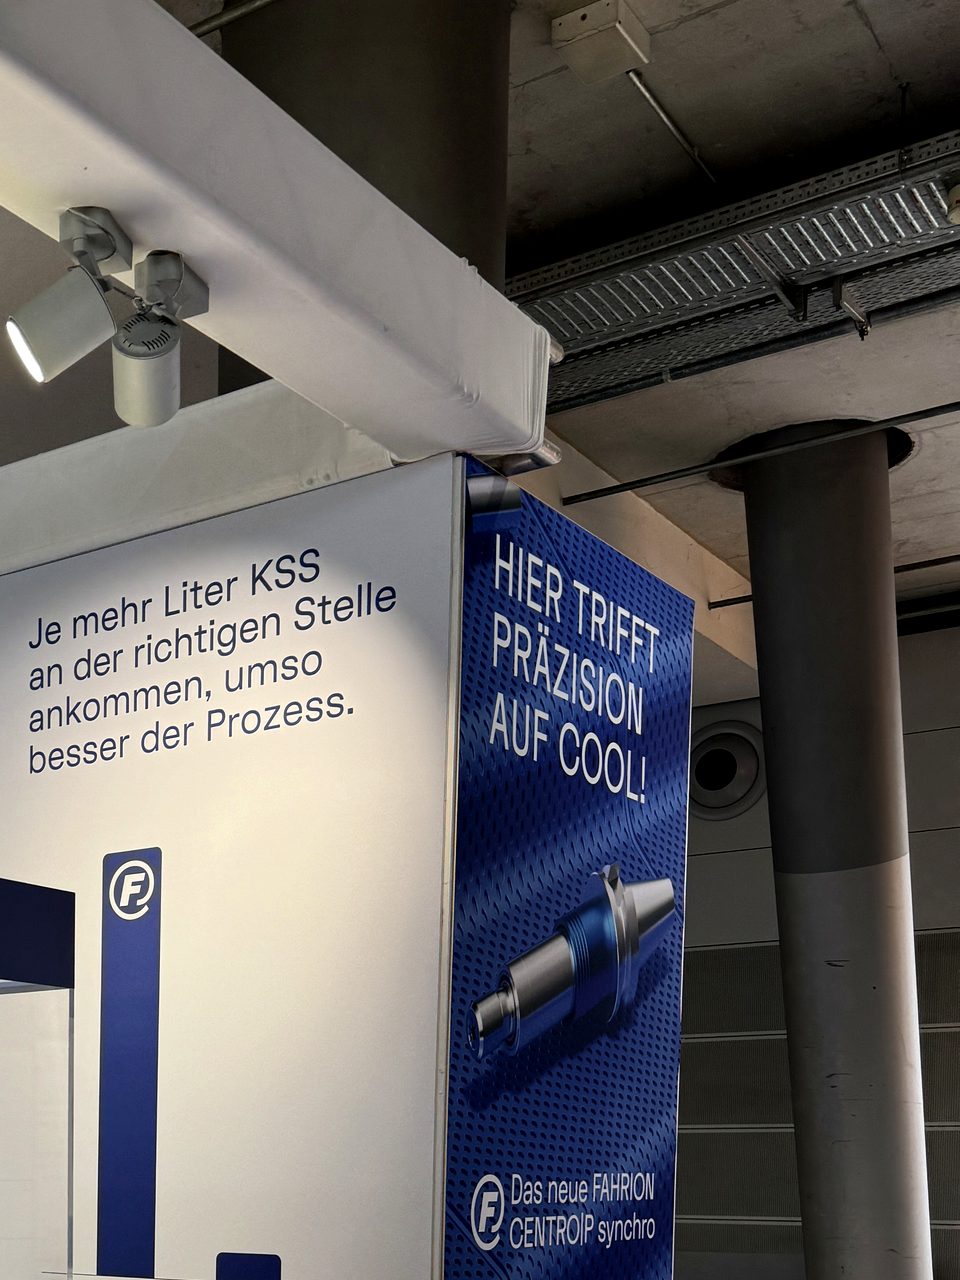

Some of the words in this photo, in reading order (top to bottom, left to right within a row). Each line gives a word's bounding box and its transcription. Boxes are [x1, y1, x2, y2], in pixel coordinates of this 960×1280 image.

[29, 617, 61, 649] Je
[73, 597, 152, 639] mehr
[164, 574, 238, 617] Liter
[251, 547, 320, 595] KSS
[29, 663, 63, 690] an
[73, 648, 123, 681] der
[134, 611, 280, 668] richtigen
[294, 581, 397, 631] Stelle
[495, 533, 563, 623] HIER
[573, 579, 660, 673] TRIFFT
[29, 674, 212, 732] ankommen,
[225, 649, 323, 693] umso
[492, 611, 643, 735] PRÄZISION
[29, 733, 129, 774] besser
[140, 719, 194, 754] der
[207, 691, 355, 742] Prozess.
[489, 692, 549, 762] AUF
[558, 722, 646, 804] COOL!
[511, 1174, 543, 1205] Das
[548, 1180, 588, 1204] neue
[592, 1172, 655, 1202] FAHRION
[597, 1212, 656, 1249] synchro
